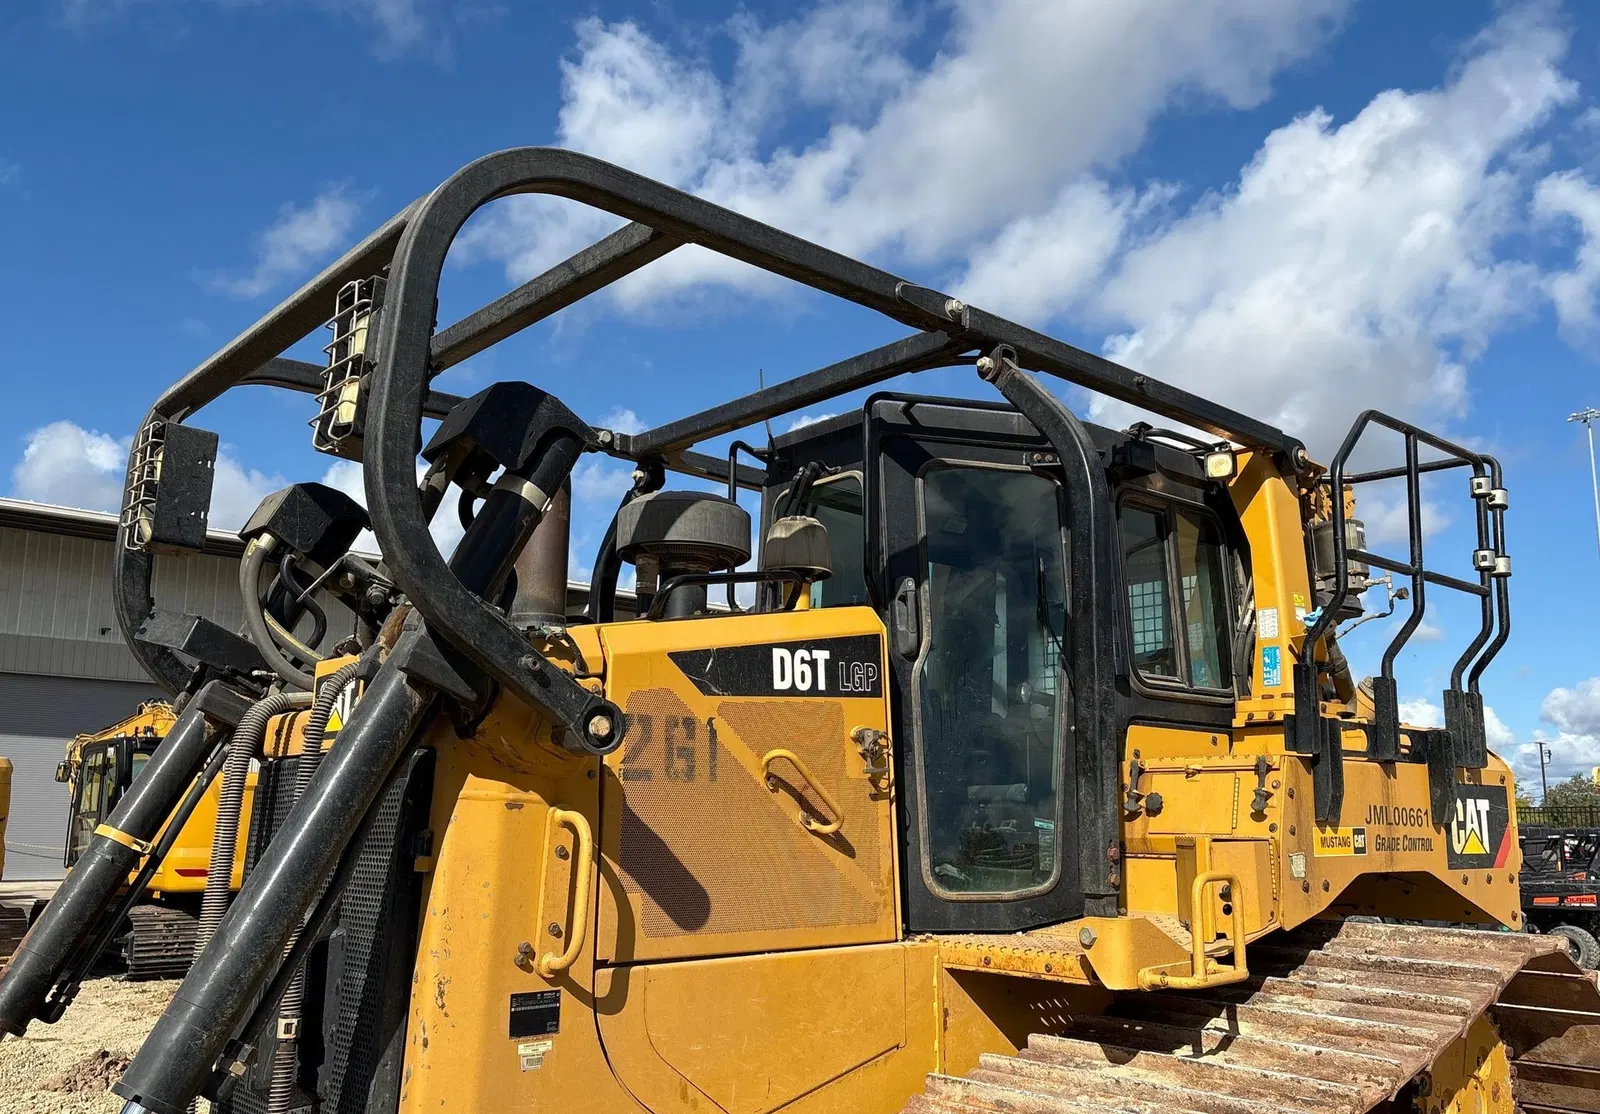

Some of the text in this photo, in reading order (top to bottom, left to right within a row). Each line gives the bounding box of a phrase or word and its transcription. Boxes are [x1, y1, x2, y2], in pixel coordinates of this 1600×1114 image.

[772, 647, 878, 692] D6T LGP
[1365, 804, 1430, 828] JML00661
[1451, 797, 1490, 855] CAT
[1320, 833, 1365, 849] MUSTANG CAT
[1375, 833, 1434, 852] GRADE CONTROL
